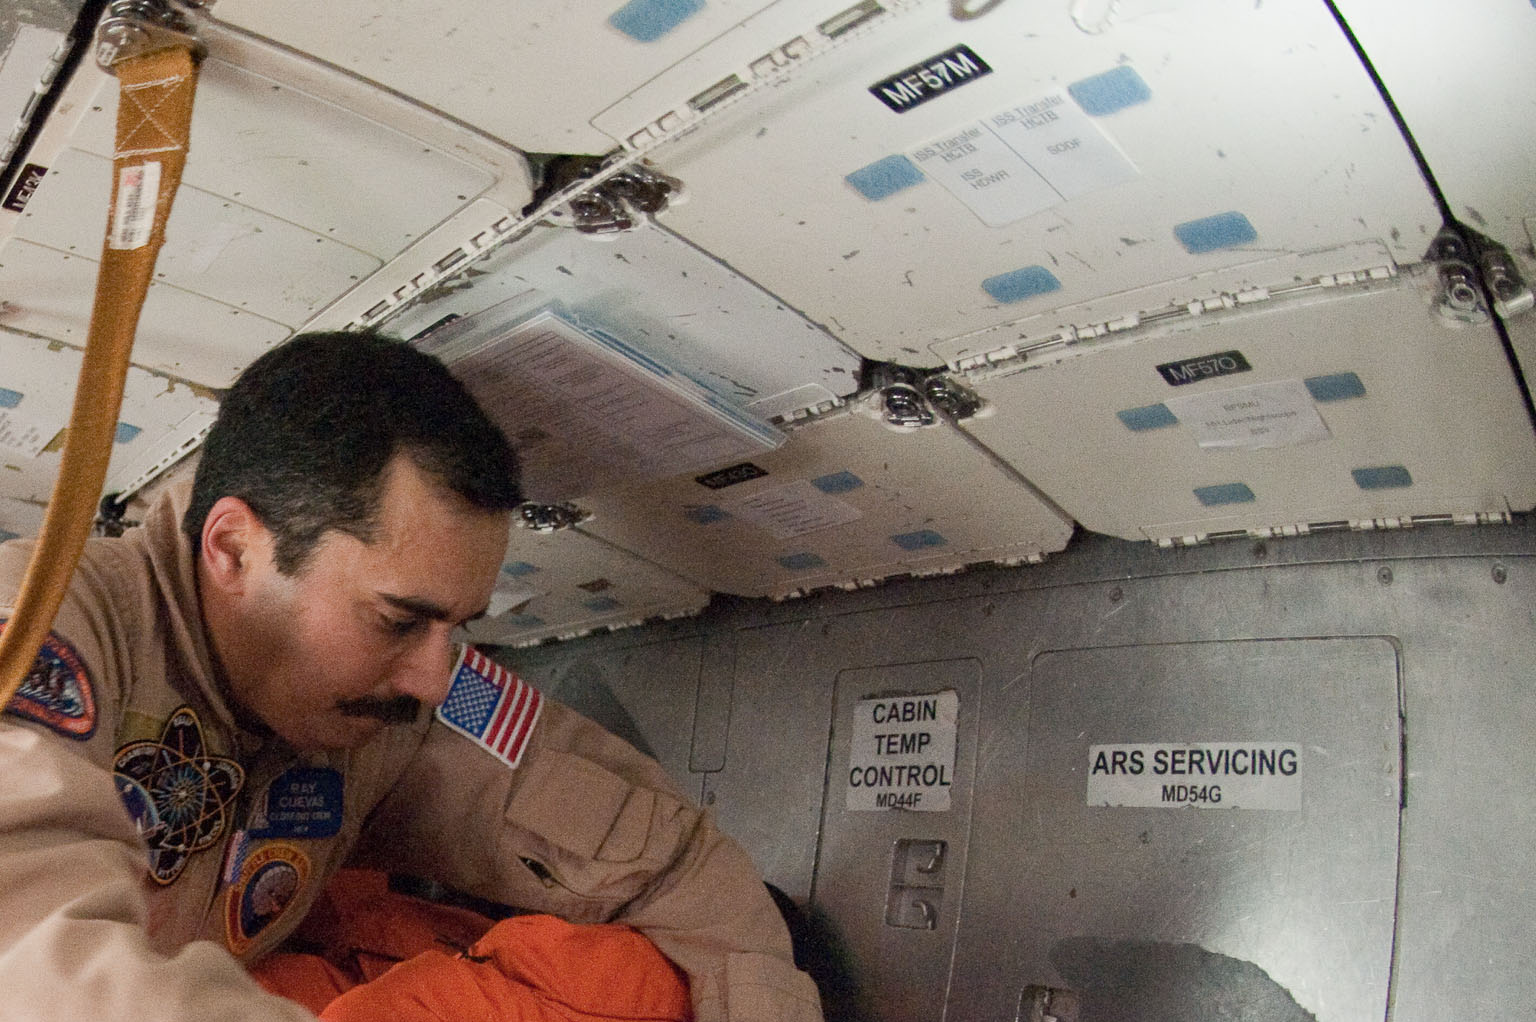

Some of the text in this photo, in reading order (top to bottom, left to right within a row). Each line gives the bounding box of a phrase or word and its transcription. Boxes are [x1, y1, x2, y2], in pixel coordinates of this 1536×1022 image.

[882, 52, 980, 108] MF57M
[991, 93, 1064, 127] ISS Transfer
[912, 126, 982, 162] ISS Transfer
[1046, 138, 1083, 155] SODF
[960, 168, 983, 182] ISS
[970, 169, 1010, 190] HDWR
[872, 700, 937, 723] CABIN
[875, 733, 931, 755] TEMP
[1092, 749, 1298, 775] ARS SERVICING
[849, 765, 951, 787] CONTROL
[875, 792, 922, 808] MD44F
[1161, 786, 1222, 803] MD54G
